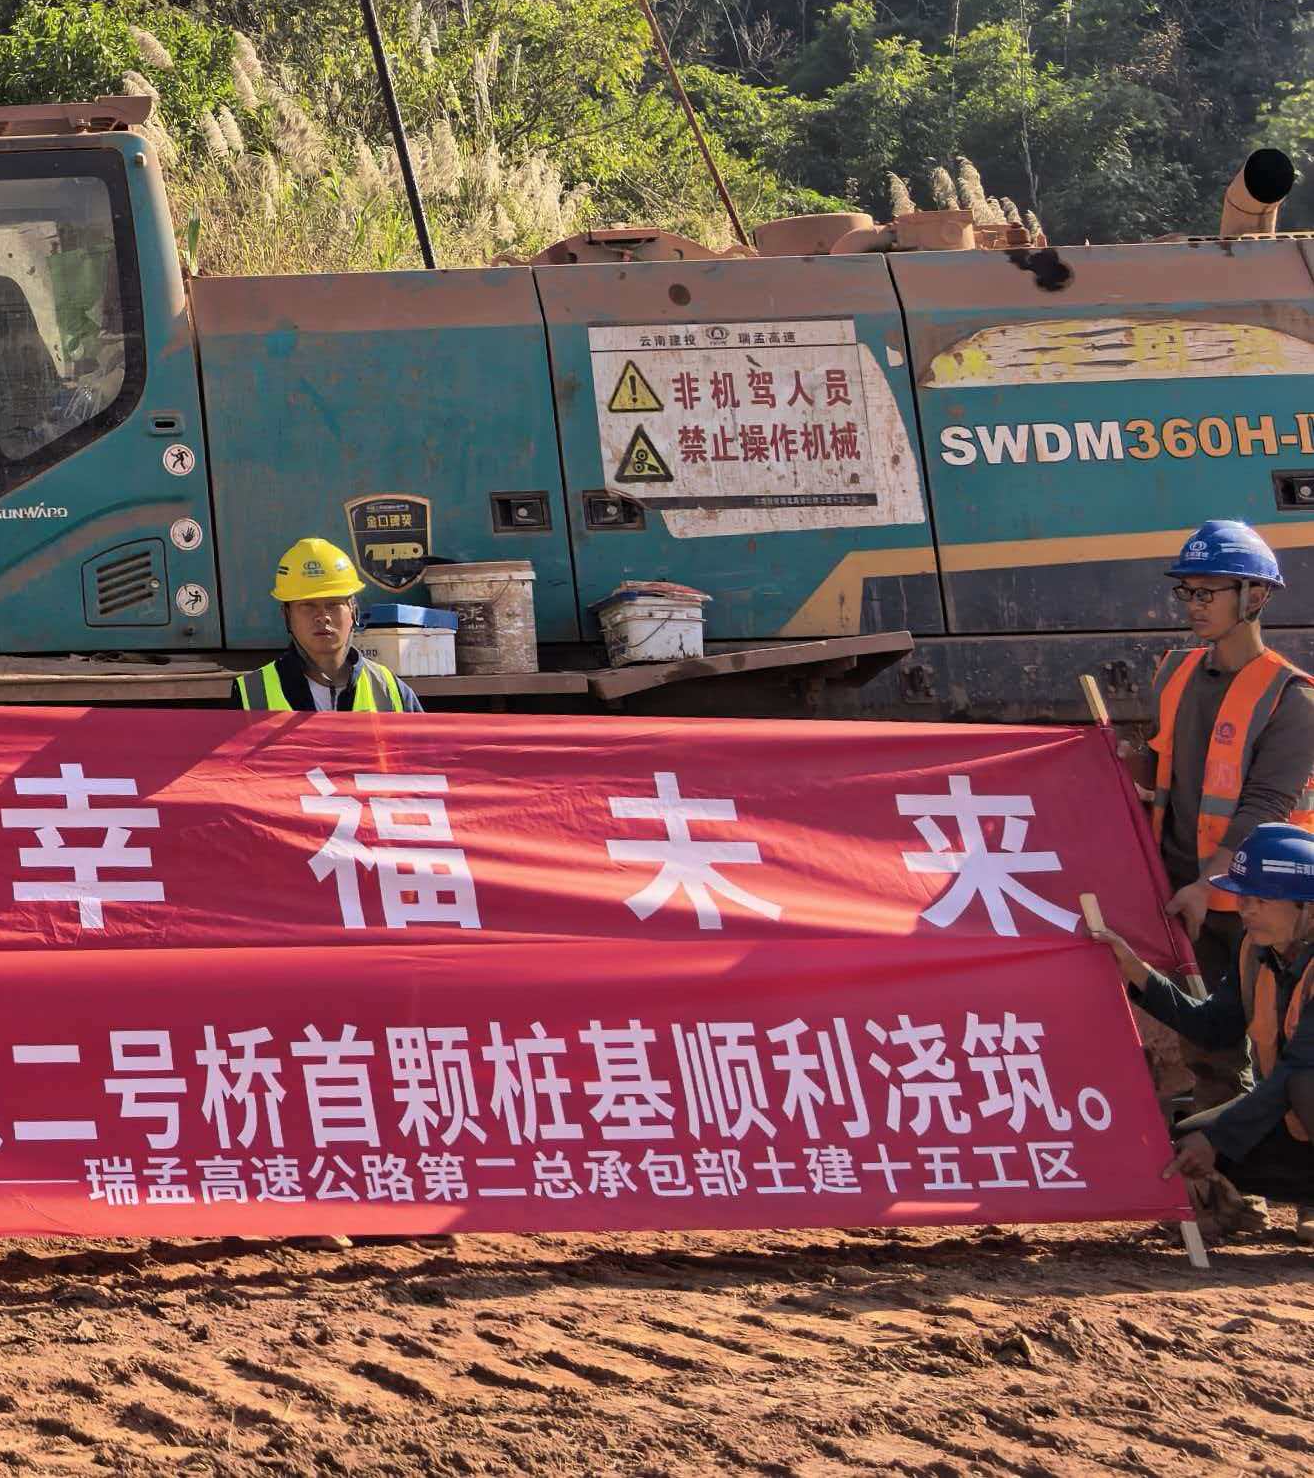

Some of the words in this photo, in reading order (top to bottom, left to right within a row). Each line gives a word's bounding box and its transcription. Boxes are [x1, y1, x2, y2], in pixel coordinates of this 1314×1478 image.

[639, 333, 697, 347] 云南建投
[738, 331, 796, 346] 瑞孟高速
[672, 369, 853, 410] 非机驾人员
[678, 422, 861, 463] 禁止操作机械
